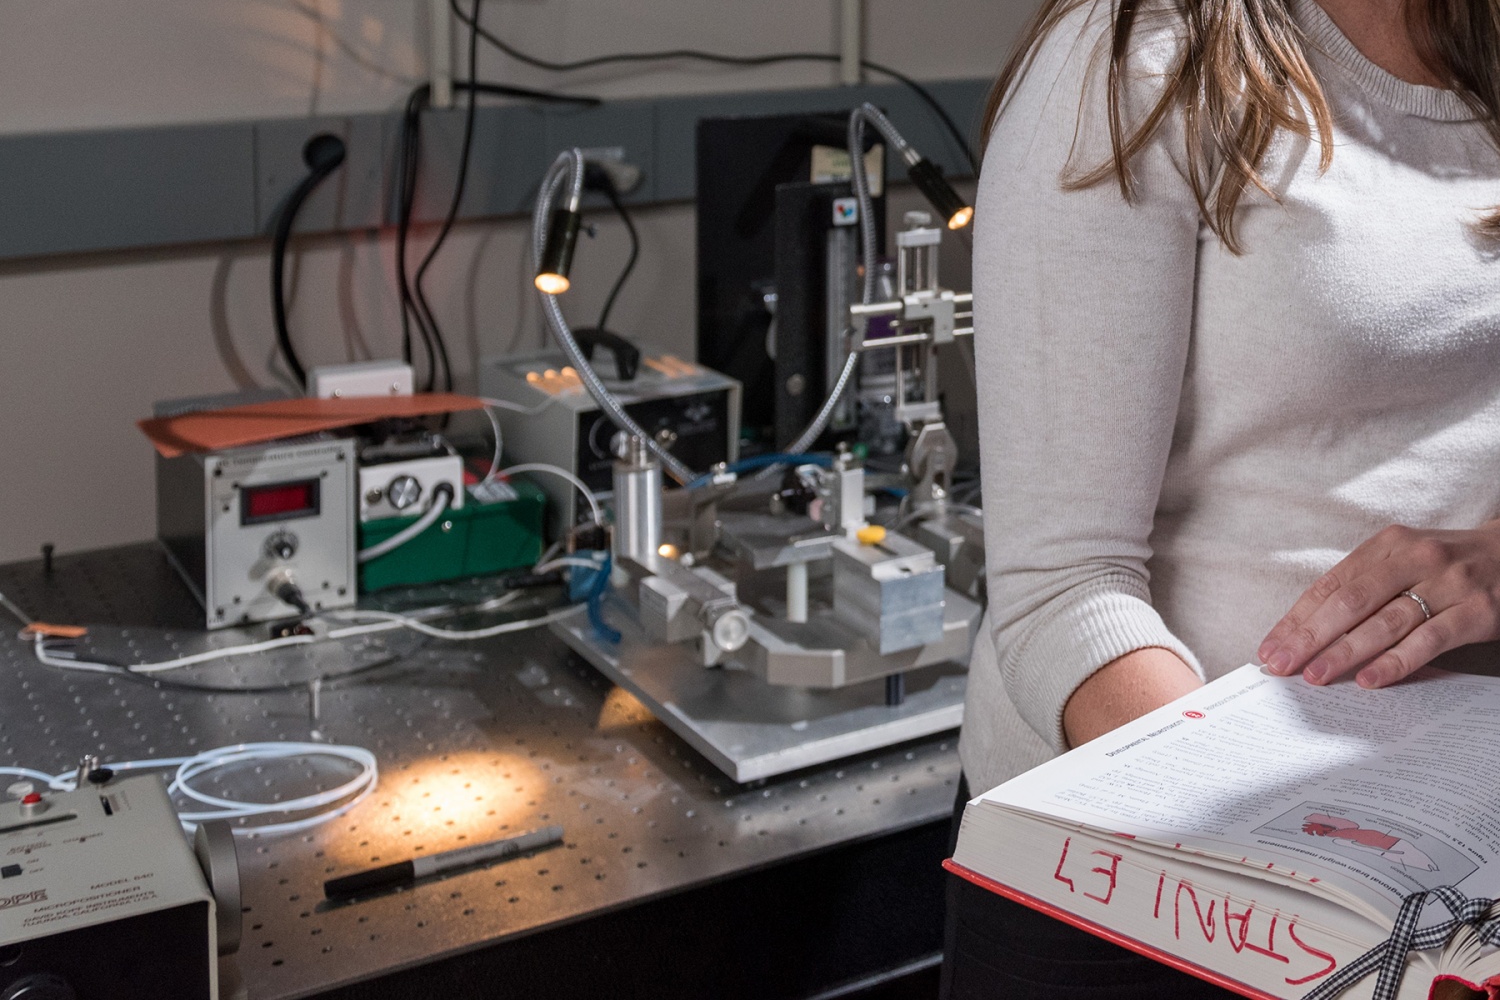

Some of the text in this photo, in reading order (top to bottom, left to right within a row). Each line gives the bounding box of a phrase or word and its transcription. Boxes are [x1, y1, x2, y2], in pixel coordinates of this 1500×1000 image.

[1464, 829, 1483, 843] brain
[1257, 840, 1318, 858] measurements
[1468, 847, 1488, 864] Figure
[1486, 844, 1500, 856] The
[1319, 855, 1348, 869] weight
[1348, 865, 1370, 879] brain
[90, 878, 129, 890] MODEL
[24, 890, 155, 923] DAVID KOPF INSTRUMENTS
[33, 885, 141, 914] MICROPOSITIONER
